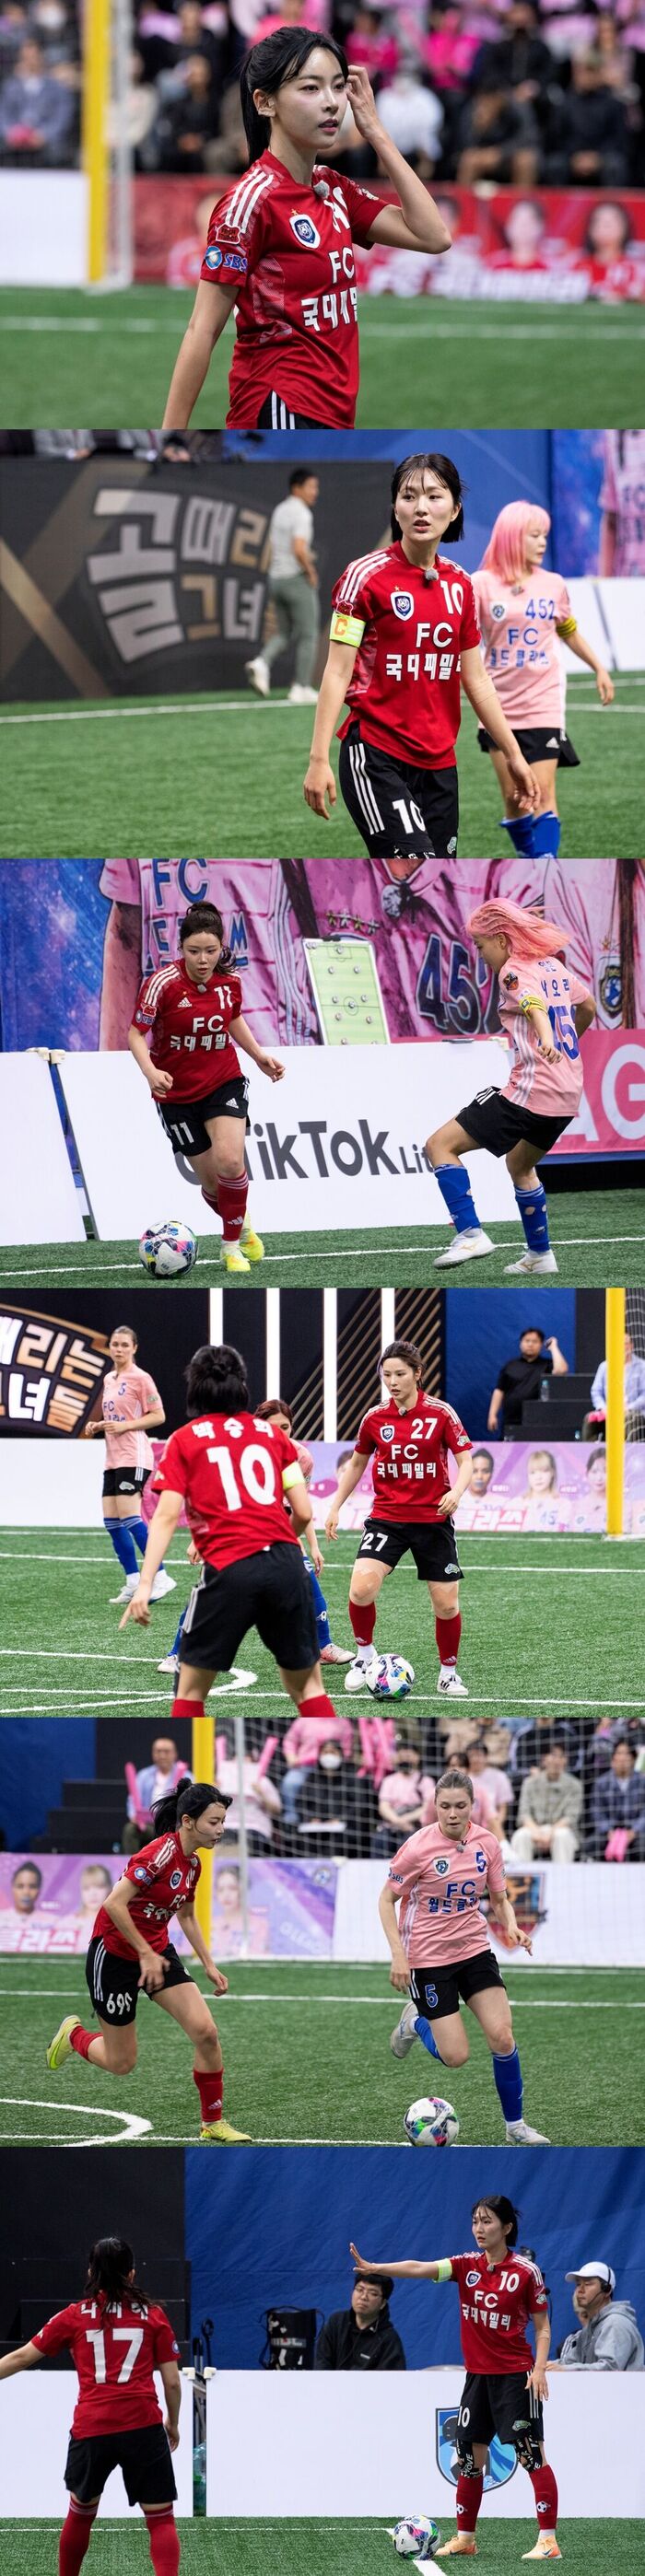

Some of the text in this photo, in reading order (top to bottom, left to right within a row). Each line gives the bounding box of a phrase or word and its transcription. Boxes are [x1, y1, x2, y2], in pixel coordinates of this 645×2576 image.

[223, 253, 248, 272] SBS
[329, 247, 355, 284] FC
[440, 579, 463, 615] 10
[525, 599, 555, 620] 452
[334, 618, 347, 636] C
[416, 622, 453, 648] FC
[508, 628, 538, 646] FC
[392, 798, 426, 834] 10
[151, 858, 208, 906] FC
[214, 985, 233, 1009] 11
[193, 1015, 224, 1032] FC
[170, 1122, 194, 1146] 11
[118, 1382, 127, 1396] 5
[103, 1401, 115, 1412] FC
[410, 1418, 438, 1440] 27
[391, 1444, 419, 1460] FC
[206, 1444, 276, 1511] 10
[377, 1463, 437, 1479] 국대패밀리
[360, 1533, 388, 1552] 27
[475, 1851, 487, 1873] 5
[446, 1881, 476, 1899] FC
[425, 1984, 439, 2009] 5
[498, 2271, 520, 2292] 10
[474, 2290, 498, 2309] FC
[86, 2327, 144, 2384] 17
[457, 2406, 470, 2428] 10
